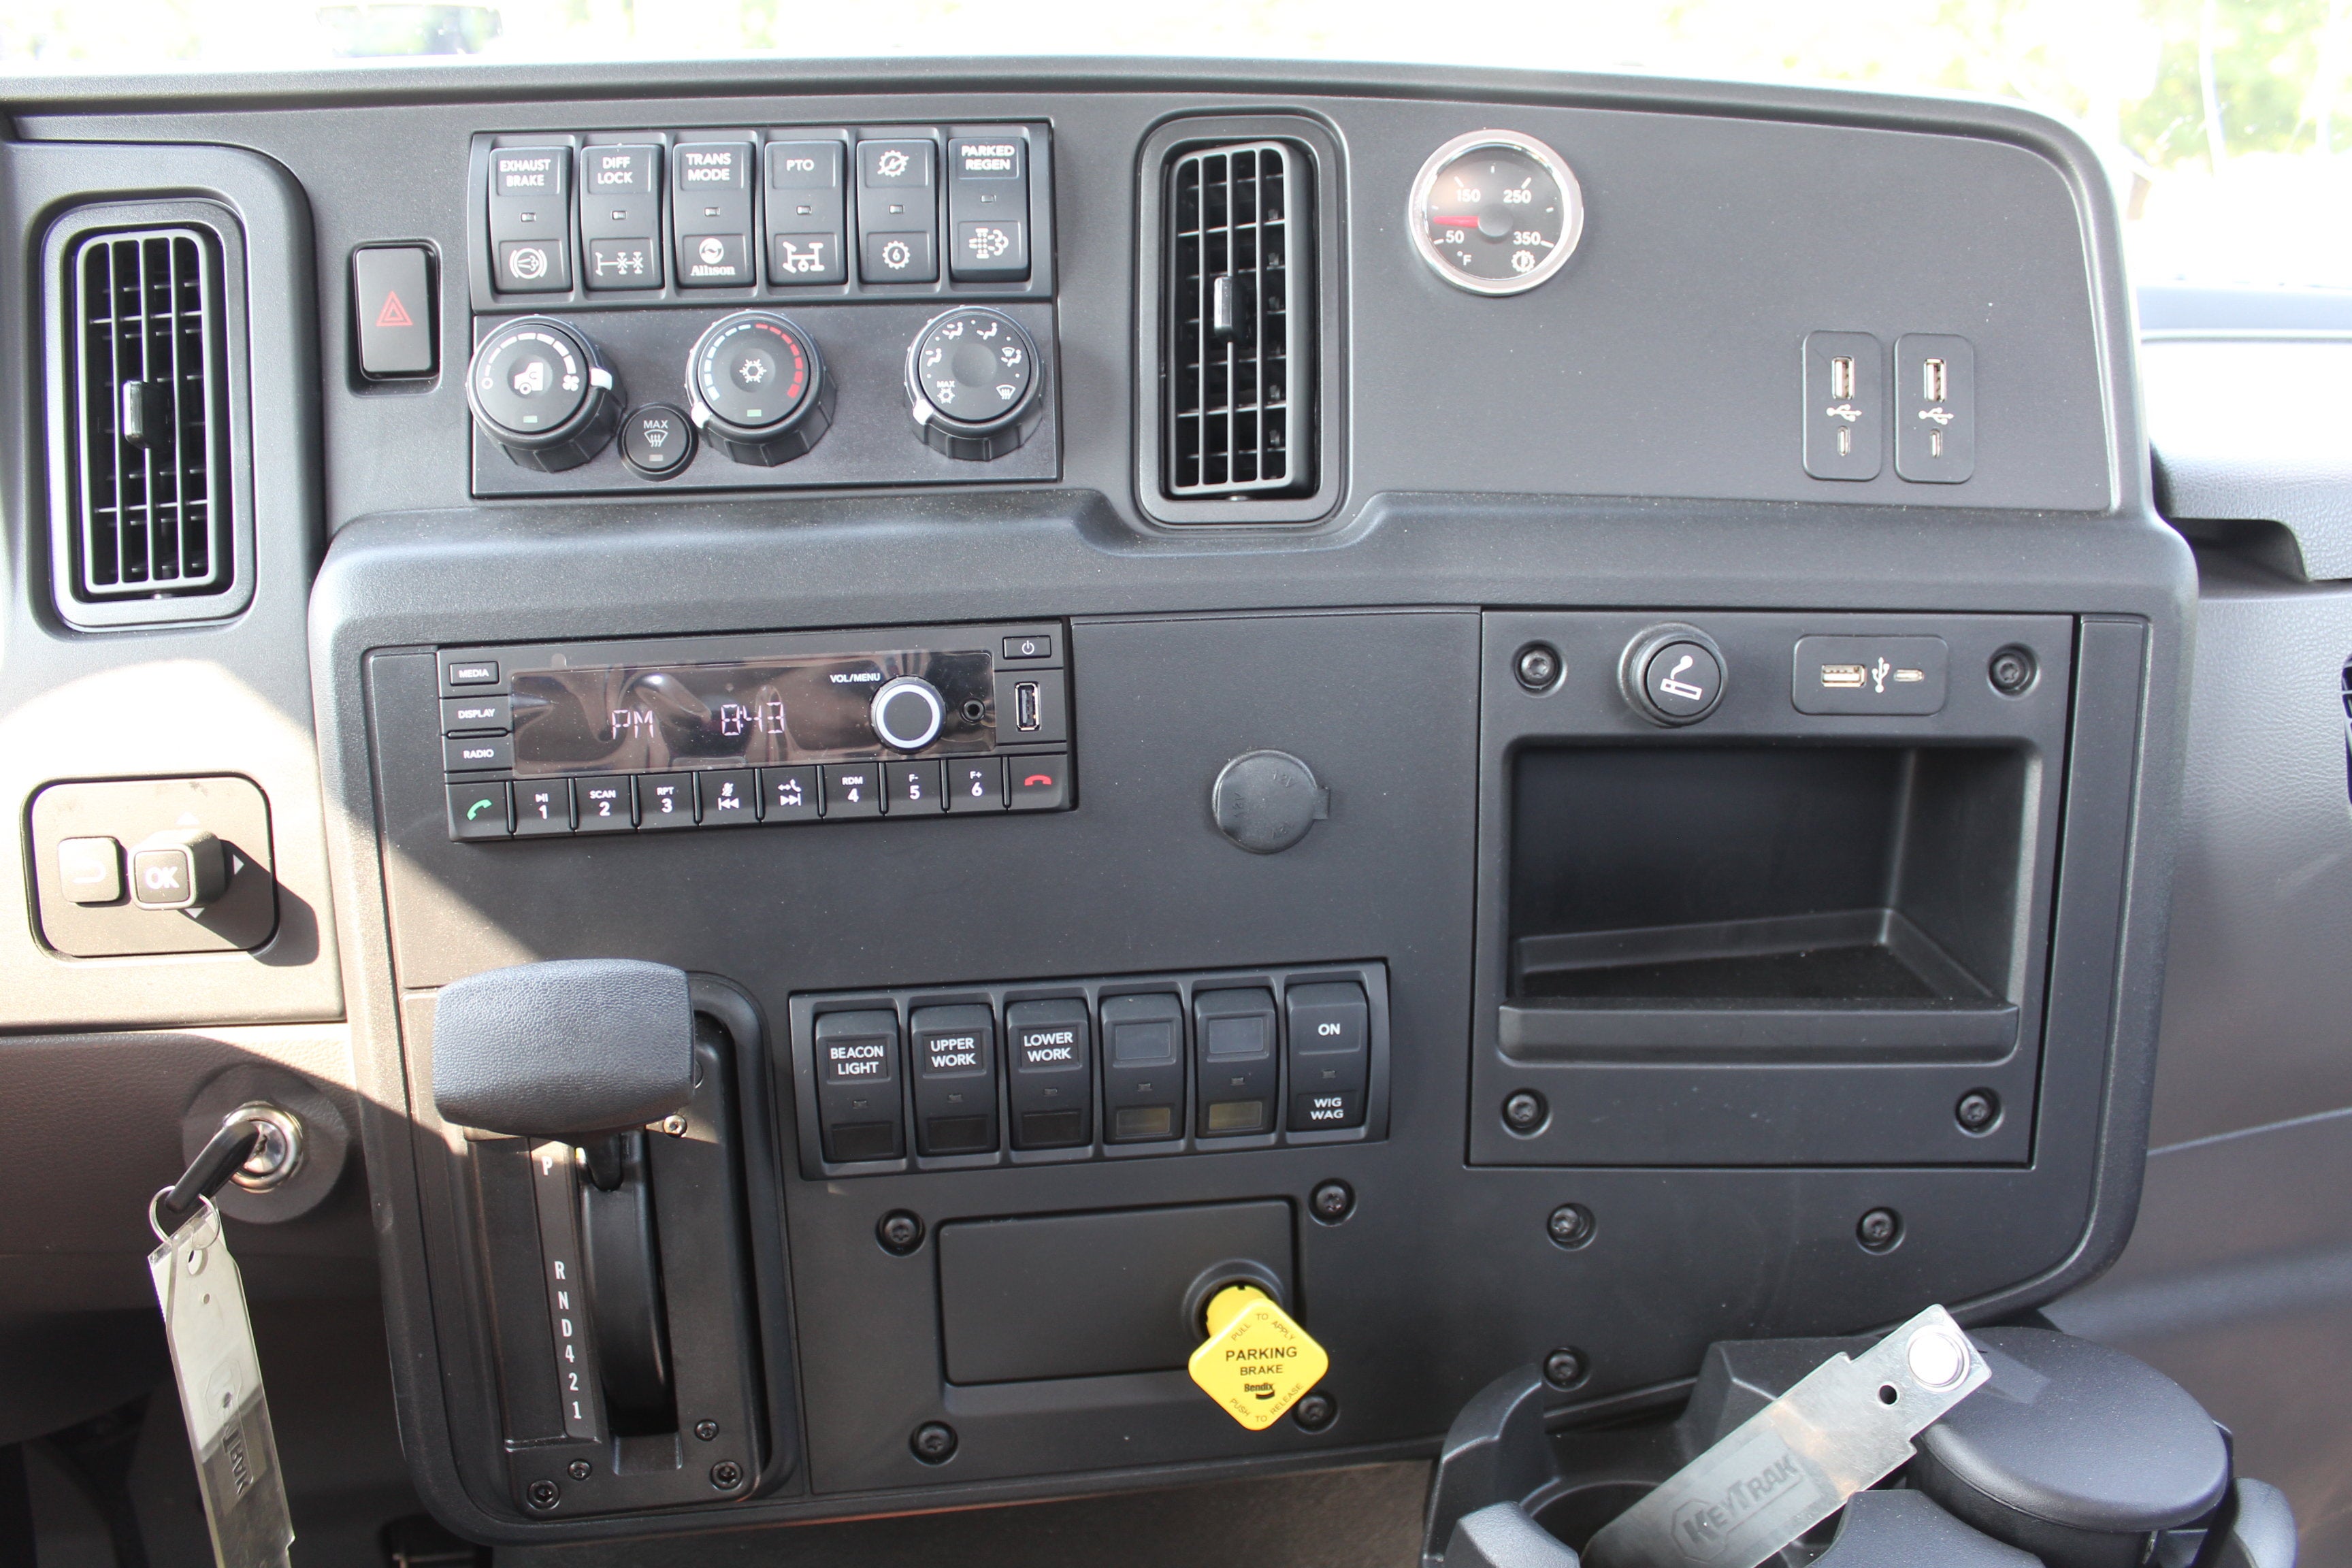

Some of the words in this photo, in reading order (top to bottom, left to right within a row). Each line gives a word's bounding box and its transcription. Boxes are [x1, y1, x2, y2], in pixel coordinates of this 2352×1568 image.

[961, 146, 1015, 157] PARKED
[500, 159, 551, 172] EXHAUST
[602, 157, 631, 169] DIFF
[686, 153, 732, 165] TRANS
[786, 159, 815, 171] PTO
[965, 159, 1011, 170] REGEN
[506, 175, 544, 187] BRAKE
[598, 172, 633, 184] LOCK
[687, 169, 730, 181] MODE
[1456, 189, 1482, 203] 150
[1503, 189, 1532, 203] 250
[1445, 229, 1465, 244] 50
[1512, 231, 1541, 246] 350
[690, 265, 736, 277] Allison
[936, 380, 956, 389] MAX
[643, 420, 669, 429] MAX
[458, 668, 490, 679] MEDIA
[830, 672, 881, 683] VOL/MENU
[457, 708, 495, 719] DISPLAY
[612, 709, 654, 740] PM
[463, 749, 494, 759] RADIO
[842, 776, 864, 785] RDM
[589, 789, 616, 800] SCAN
[656, 786, 674, 796] RPT
[848, 788, 859, 802] 4
[910, 784, 920, 800] 5
[971, 782, 983, 797] 6
[538, 805, 547, 819] 1
[599, 801, 610, 817] 2
[662, 798, 673, 813] 3
[145, 866, 180, 889] OK
[1318, 1023, 1341, 1036] ON
[930, 1037, 975, 1053] UPPER
[1023, 1032, 1073, 1047] LOWER
[830, 1045, 884, 1060] BEACON
[1027, 1048, 1072, 1063] WORK
[931, 1053, 976, 1068] WORK
[837, 1062, 879, 1075] LIGHT
[1314, 1096, 1342, 1108] WIG
[1310, 1109, 1344, 1121] WAG
[541, 1156, 553, 1176] P
[554, 1260, 566, 1280] R
[558, 1290, 570, 1310] N
[561, 1318, 572, 1337] D
[1231, 1322, 1252, 1342] PULL
[1271, 1320, 1296, 1341] APPLY
[564, 1344, 575, 1364] 4
[1225, 1345, 1298, 1362] PARKING
[1239, 1364, 1284, 1376] BRAKE
[568, 1372, 579, 1392] 2
[1243, 1382, 1275, 1393] Bendix
[1229, 1397, 1252, 1417] PUSH
[1255, 1415, 1267, 1423] TO
[1269, 1382, 1304, 1416] RELEASE
[572, 1401, 582, 1420] 1
